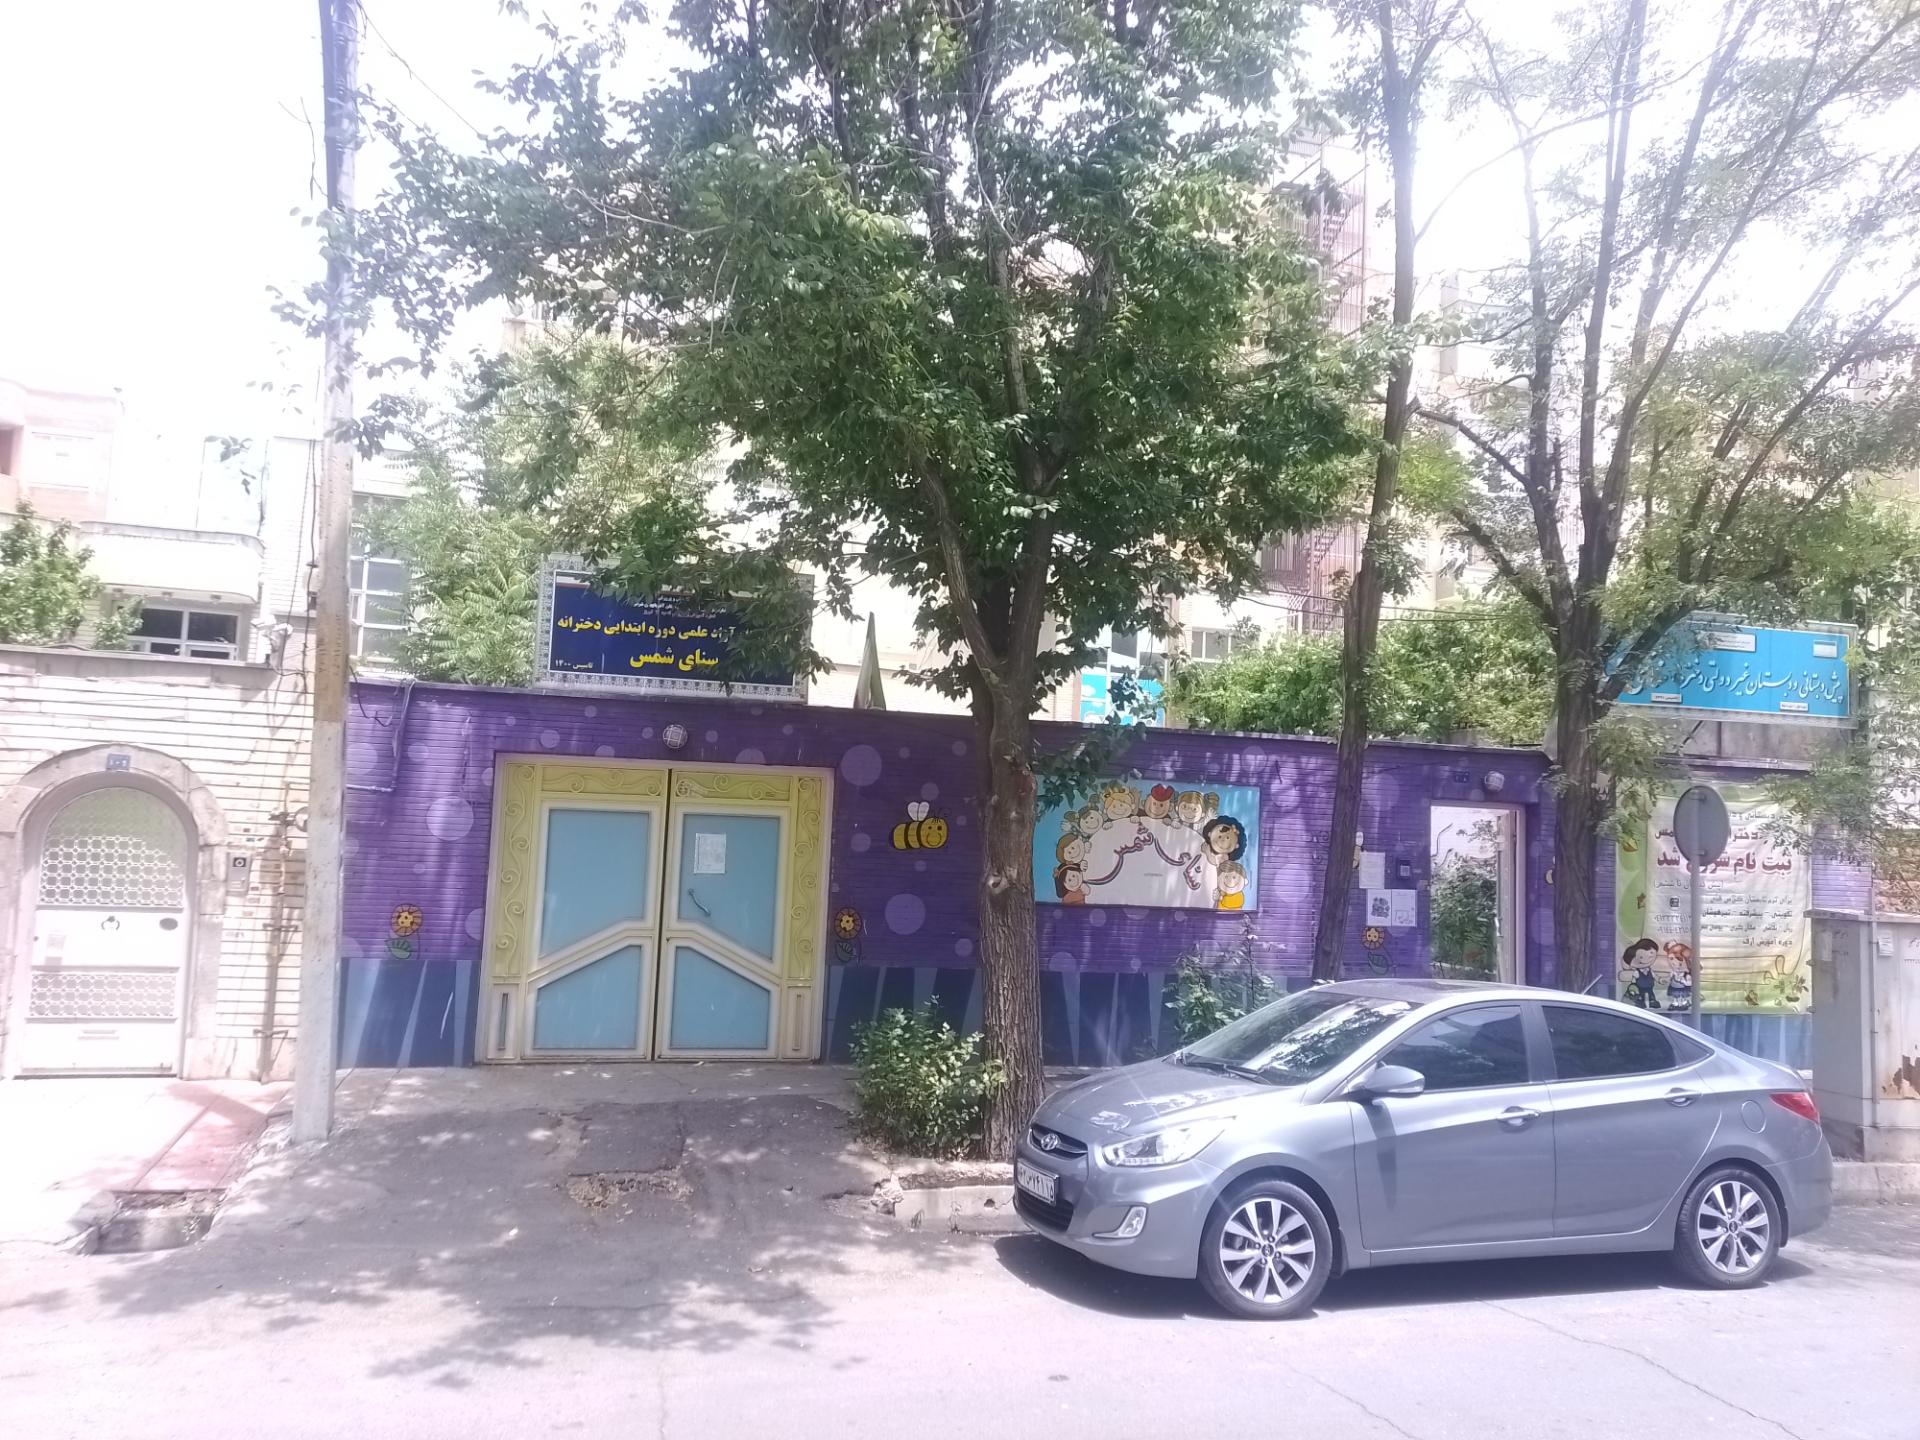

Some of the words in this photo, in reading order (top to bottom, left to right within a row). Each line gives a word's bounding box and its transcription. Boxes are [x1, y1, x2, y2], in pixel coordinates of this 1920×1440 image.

[557, 616, 601, 632] دخترانه
[604, 619, 646, 635] ابتدایی
[648, 624, 676, 639] دوره
[678, 626, 708, 640] علمی
[629, 646, 675, 668] شمس
[678, 648, 719, 671] سنای
[1703, 660, 1731, 692] دولتی
[1729, 662, 1751, 696] غیر
[1746, 672, 1792, 697] دبستان
[1798, 670, 1825, 699] دبستانی
[1824, 671, 1844, 703] پیش
[1655, 828, 1674, 840] مس
[1083, 821, 1155, 885] شمس
[1657, 846, 1680, 866] شد
[1733, 853, 1756, 874] نام
